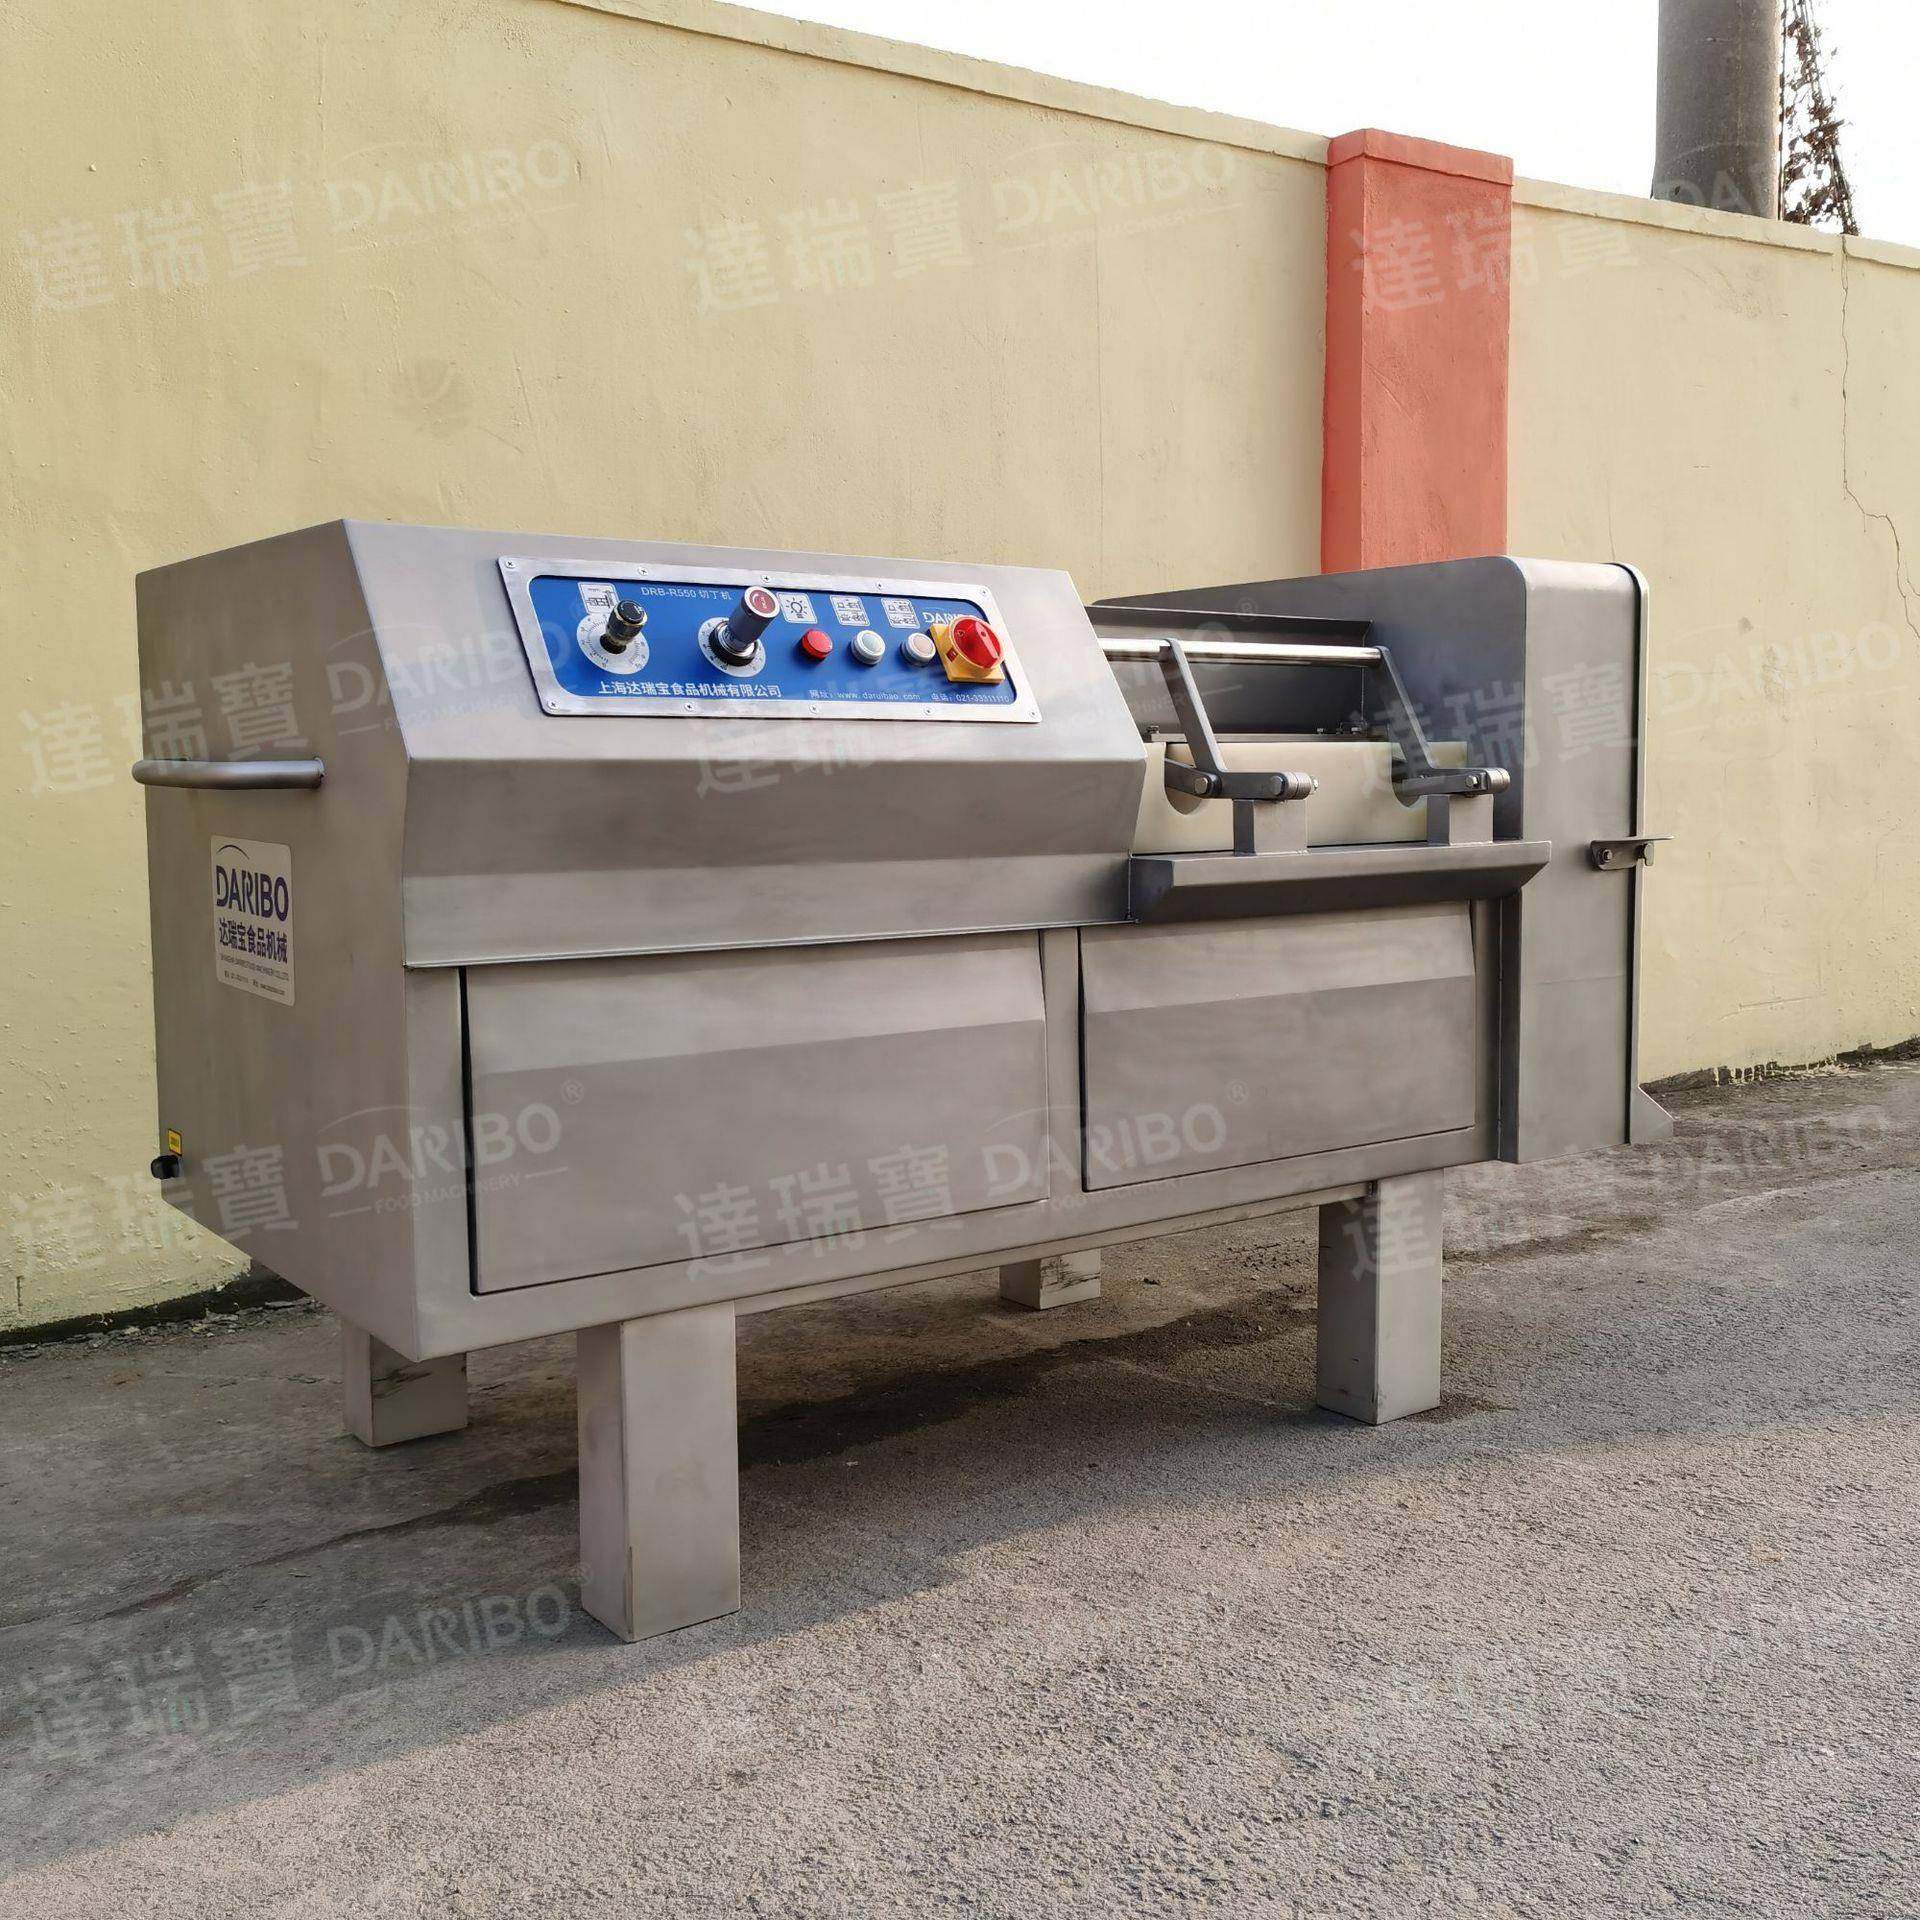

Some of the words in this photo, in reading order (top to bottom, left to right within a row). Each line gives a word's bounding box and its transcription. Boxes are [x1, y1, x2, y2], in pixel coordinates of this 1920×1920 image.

[641, 586, 696, 599] DRB-R550
[598, 681, 782, 698] 上海达瑞宝食品机械有限公司
[216, 865, 289, 922] DARIBO
[219, 917, 288, 964] 达瑞宝食品机械
